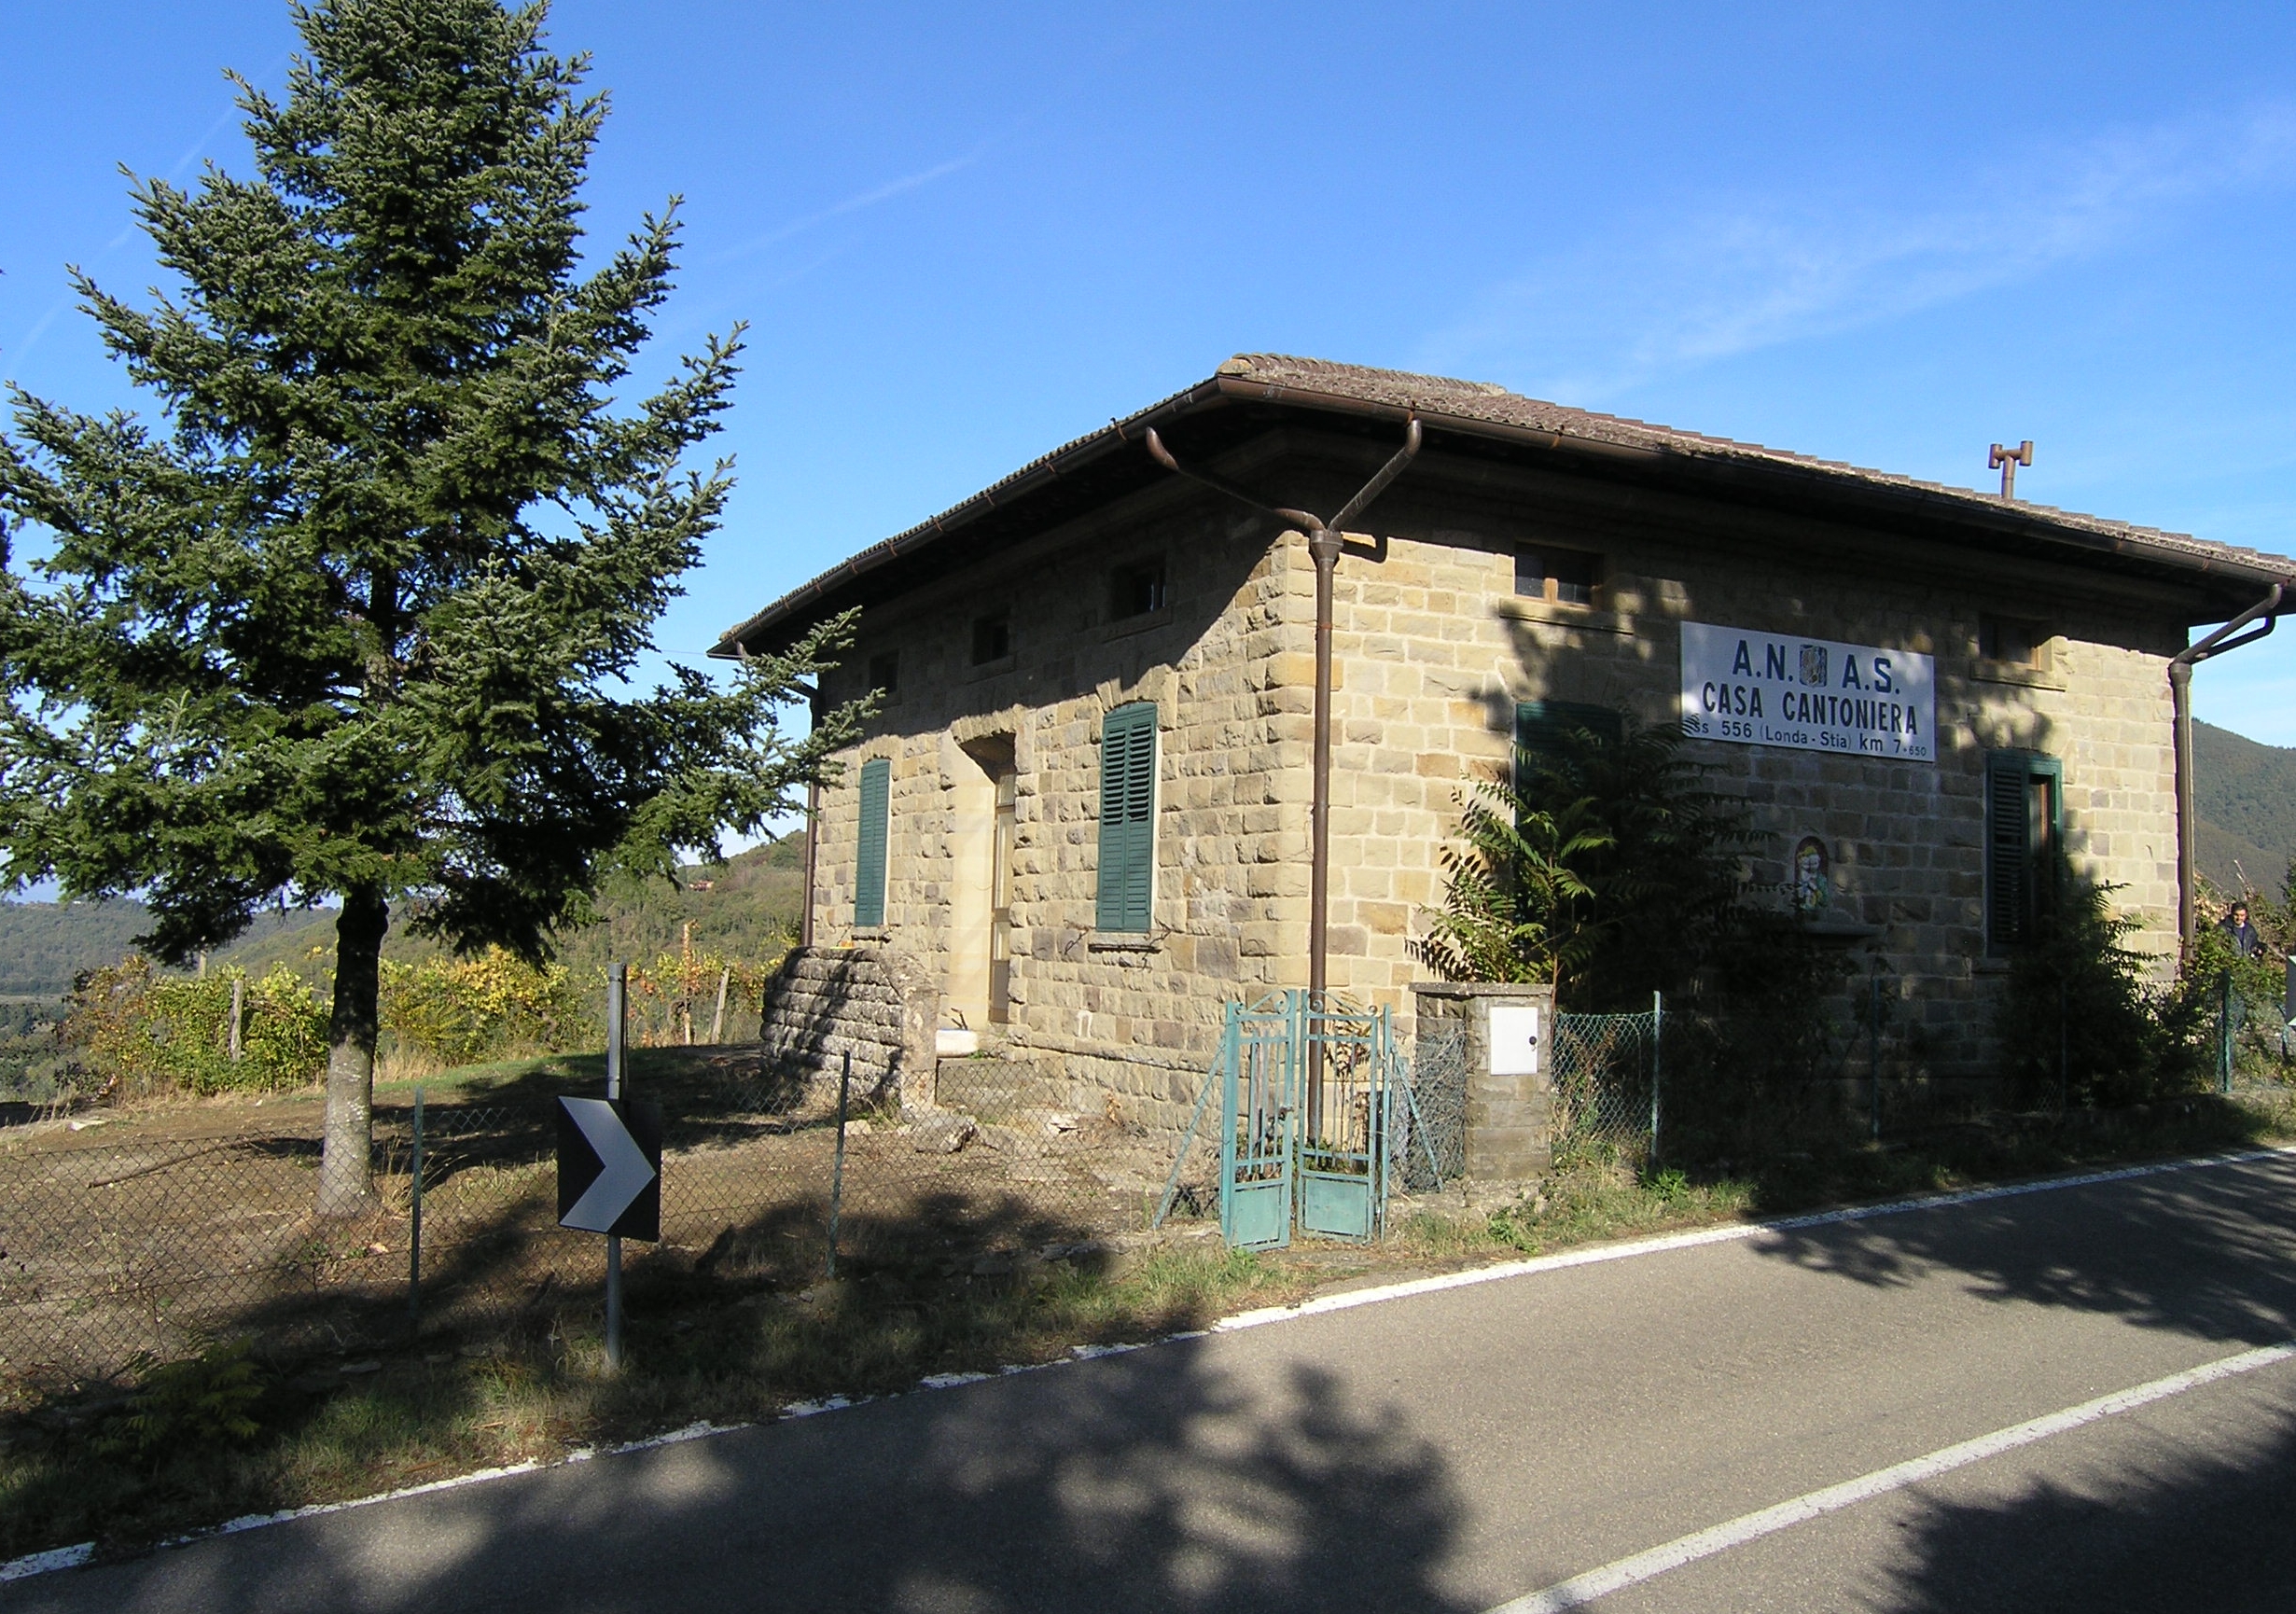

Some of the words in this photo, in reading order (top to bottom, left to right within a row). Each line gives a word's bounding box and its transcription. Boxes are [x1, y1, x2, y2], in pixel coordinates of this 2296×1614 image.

[1732, 639, 1793, 682] A.N.
[1842, 654, 1900, 694] A.S.
[1703, 681, 1762, 717] CASA
[1783, 690, 1917, 735] CANTONIERA
[1721, 720, 1752, 738] 556
[1760, 722, 1807, 744] (Londa
[1820, 730, 1852, 749] Stia)
[1859, 732, 1883, 752] km
